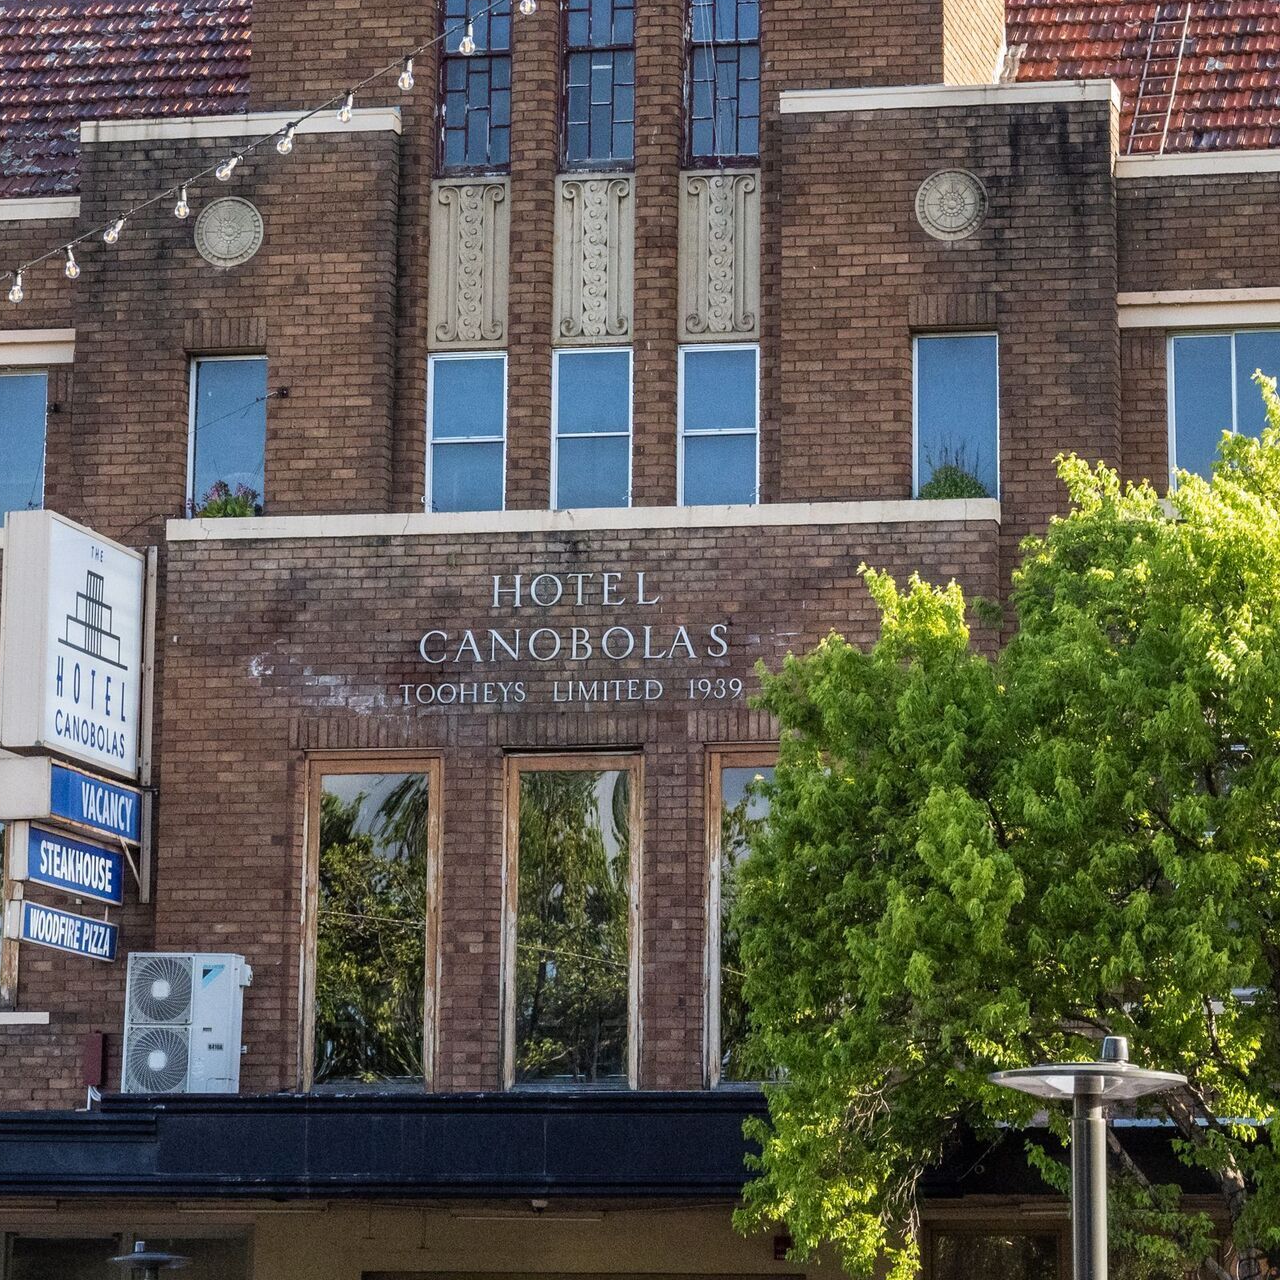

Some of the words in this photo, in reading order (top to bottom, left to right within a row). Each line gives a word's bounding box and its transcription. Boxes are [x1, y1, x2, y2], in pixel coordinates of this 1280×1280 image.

[91, 545, 104, 563] THE
[491, 571, 660, 608] HOTEL
[419, 623, 729, 664] CANOBOLAS
[56, 655, 126, 723] HOTEL
[399, 681, 527, 705] TOOHEYS
[553, 679, 664, 703] LIMITED
[688, 678, 744, 701] 1939
[55, 708, 126, 760] CANOBOLAS
[81, 780, 133, 833] VACANCY
[39, 838, 113, 894] STEAKHOUSE
[29, 906, 81, 951] WOODFIRE
[81, 921, 111, 958] PIZZA
